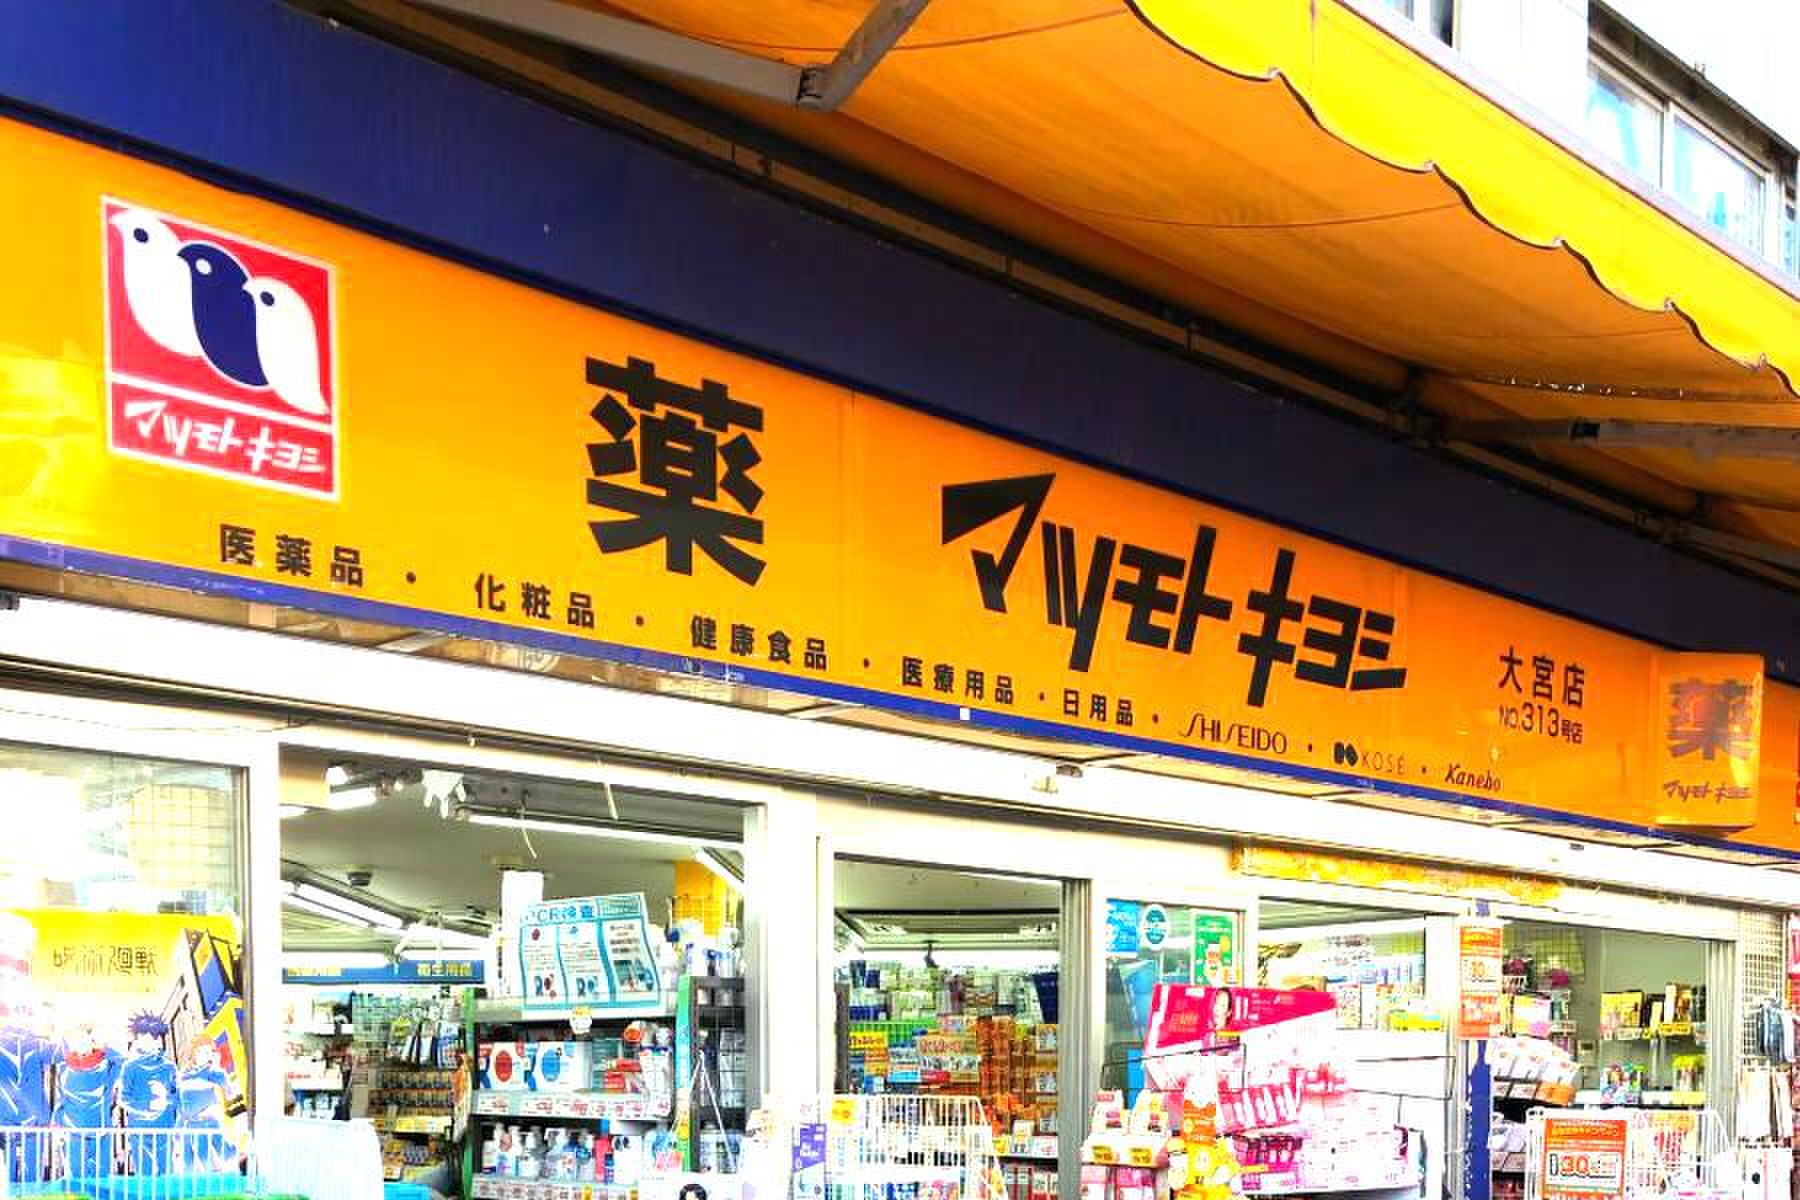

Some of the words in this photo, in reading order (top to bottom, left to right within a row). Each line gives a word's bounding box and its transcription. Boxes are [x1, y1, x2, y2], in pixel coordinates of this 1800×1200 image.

[123, 400, 327, 474] マツモトキヨシ
[586, 355, 767, 587] 薬
[219, 523, 364, 588] 医薬品
[473, 572, 595, 629] 化粧品
[690, 613, 828, 671] 健康食品
[901, 655, 1014, 705] 医療用品
[1062, 688, 1134, 727] 日用品
[1178, 712, 1288, 754] SHISEIDO
[1444, 762, 1502, 793] Kanebo
[941, 471, 1408, 708] マツモトキヨシ
[1498, 644, 1585, 709] 大宮店
